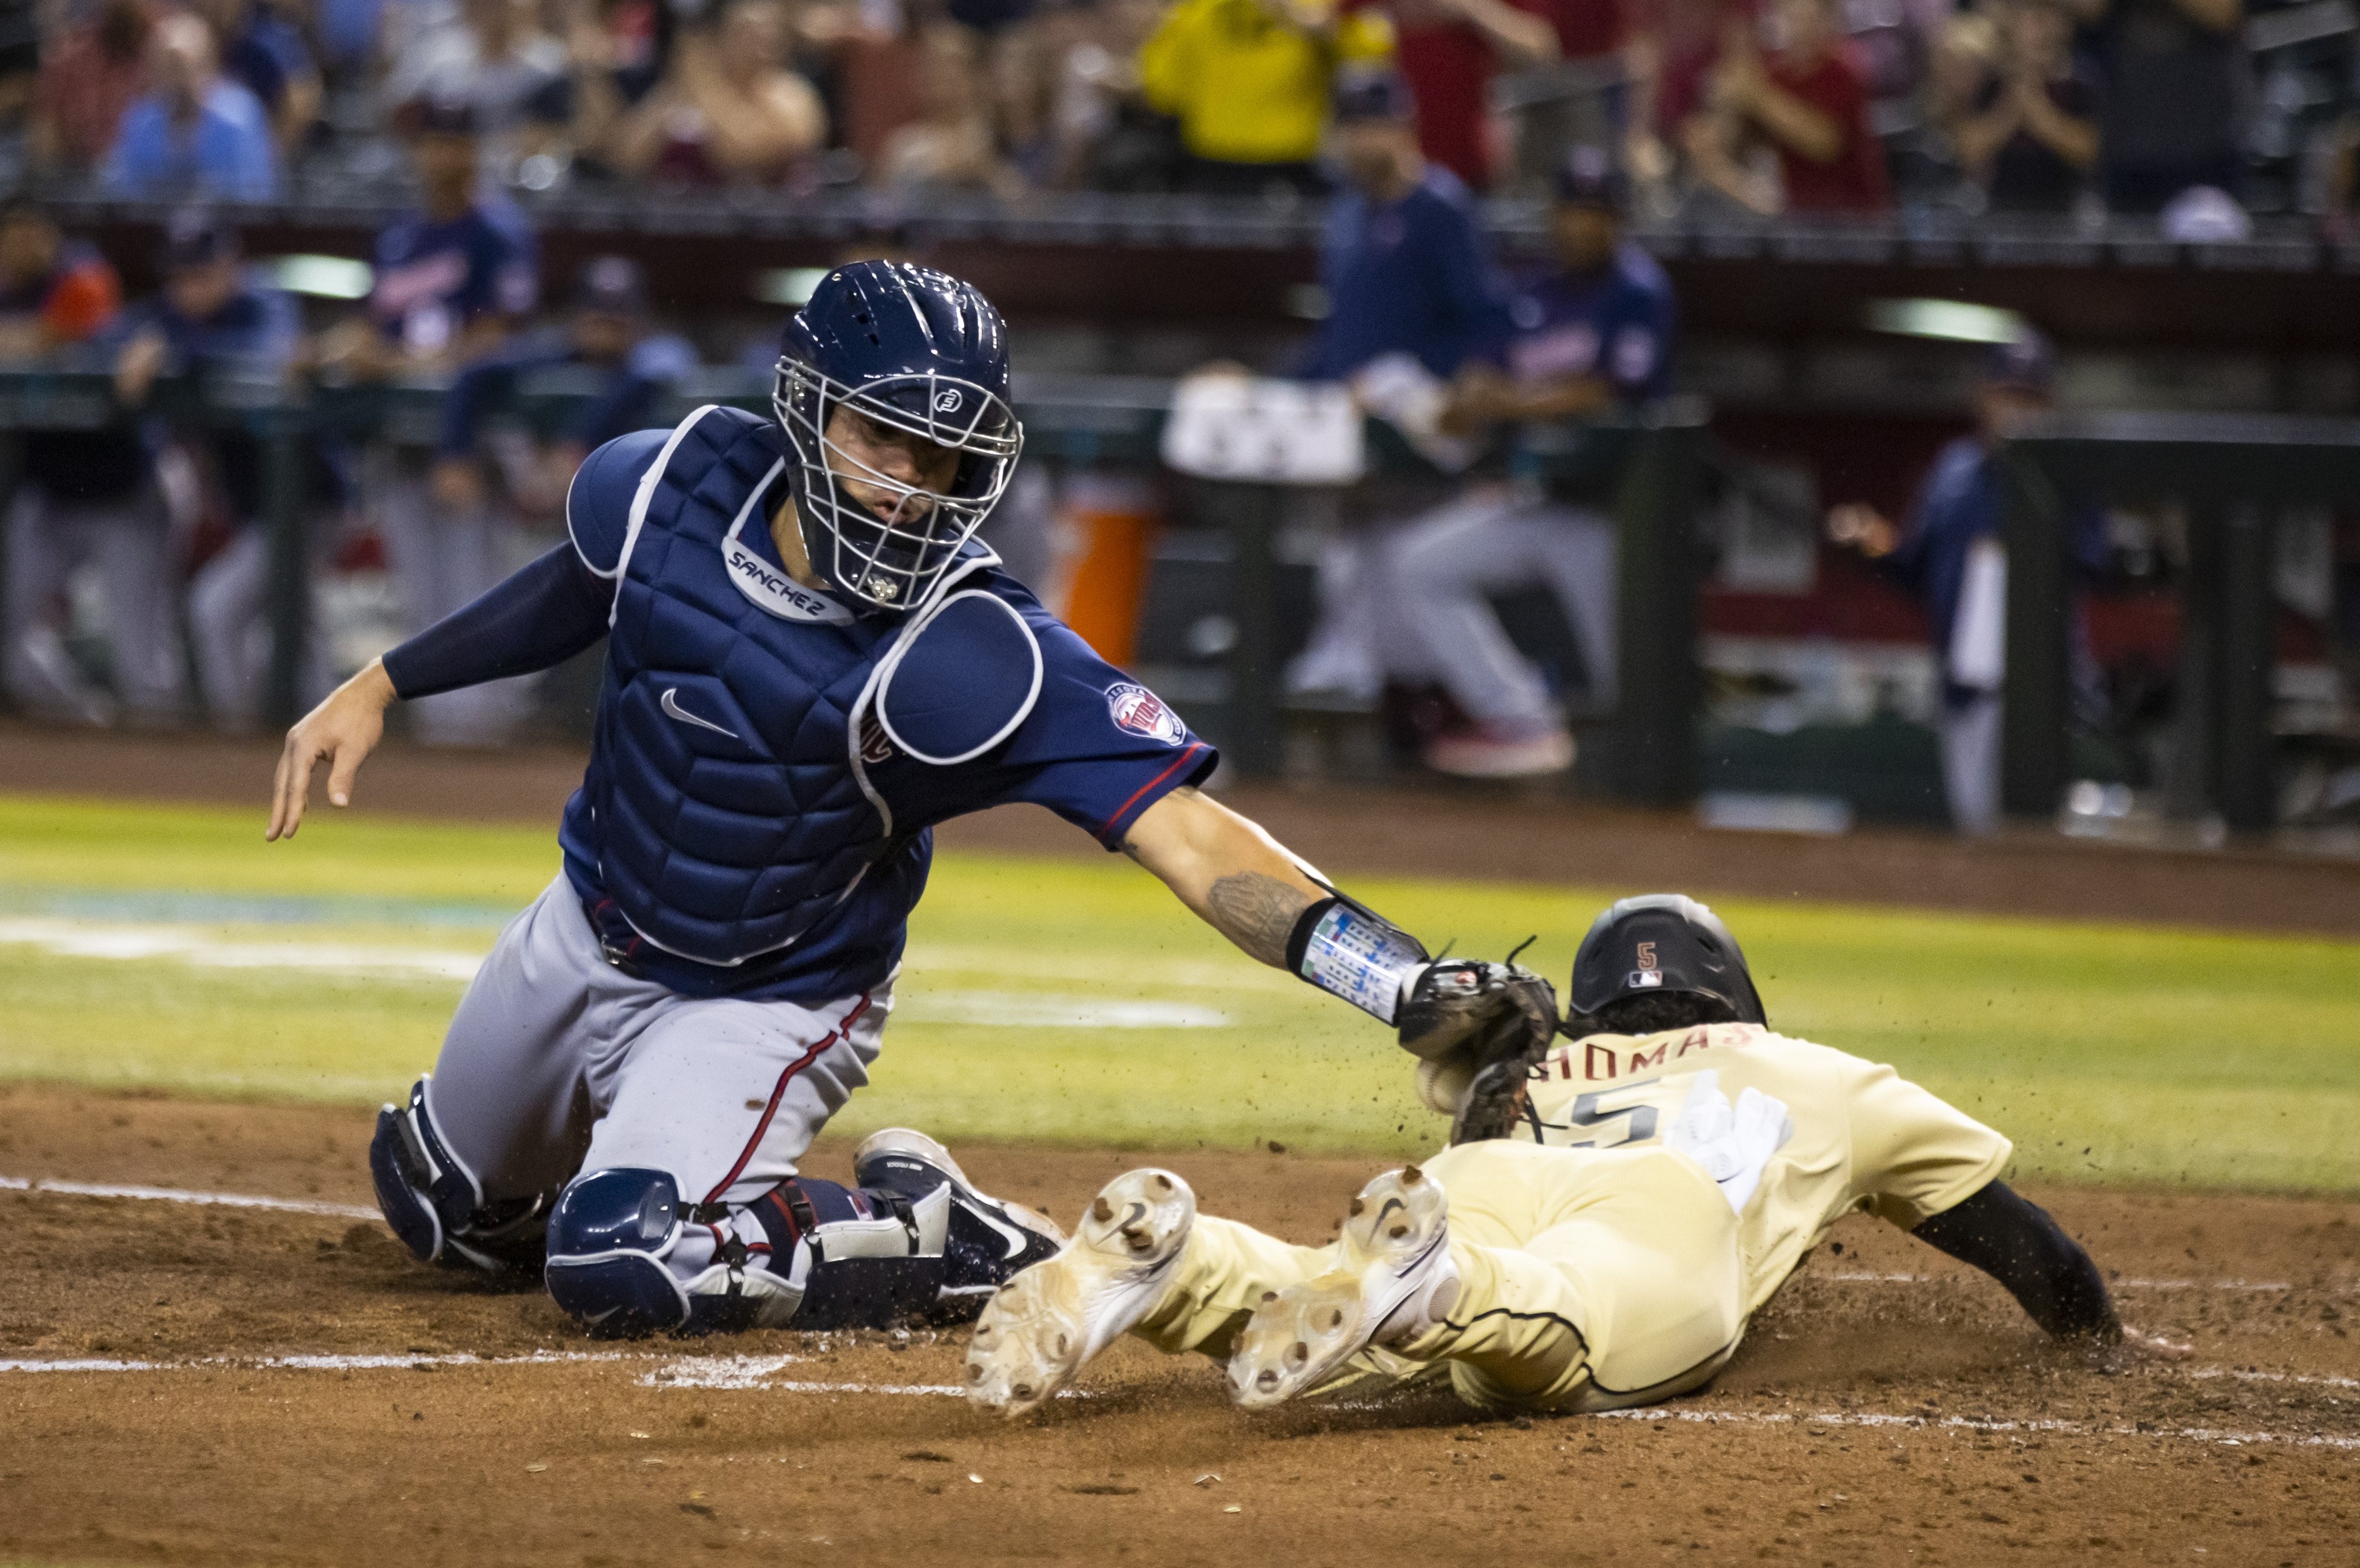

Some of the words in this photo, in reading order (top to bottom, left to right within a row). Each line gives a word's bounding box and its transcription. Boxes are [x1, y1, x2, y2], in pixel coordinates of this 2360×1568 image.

[728, 551, 826, 616] SANCHEZ
[1637, 941, 1658, 971] 5
[1535, 1021, 1762, 1082] HOMAS
[1570, 1077, 1659, 1148] 5
